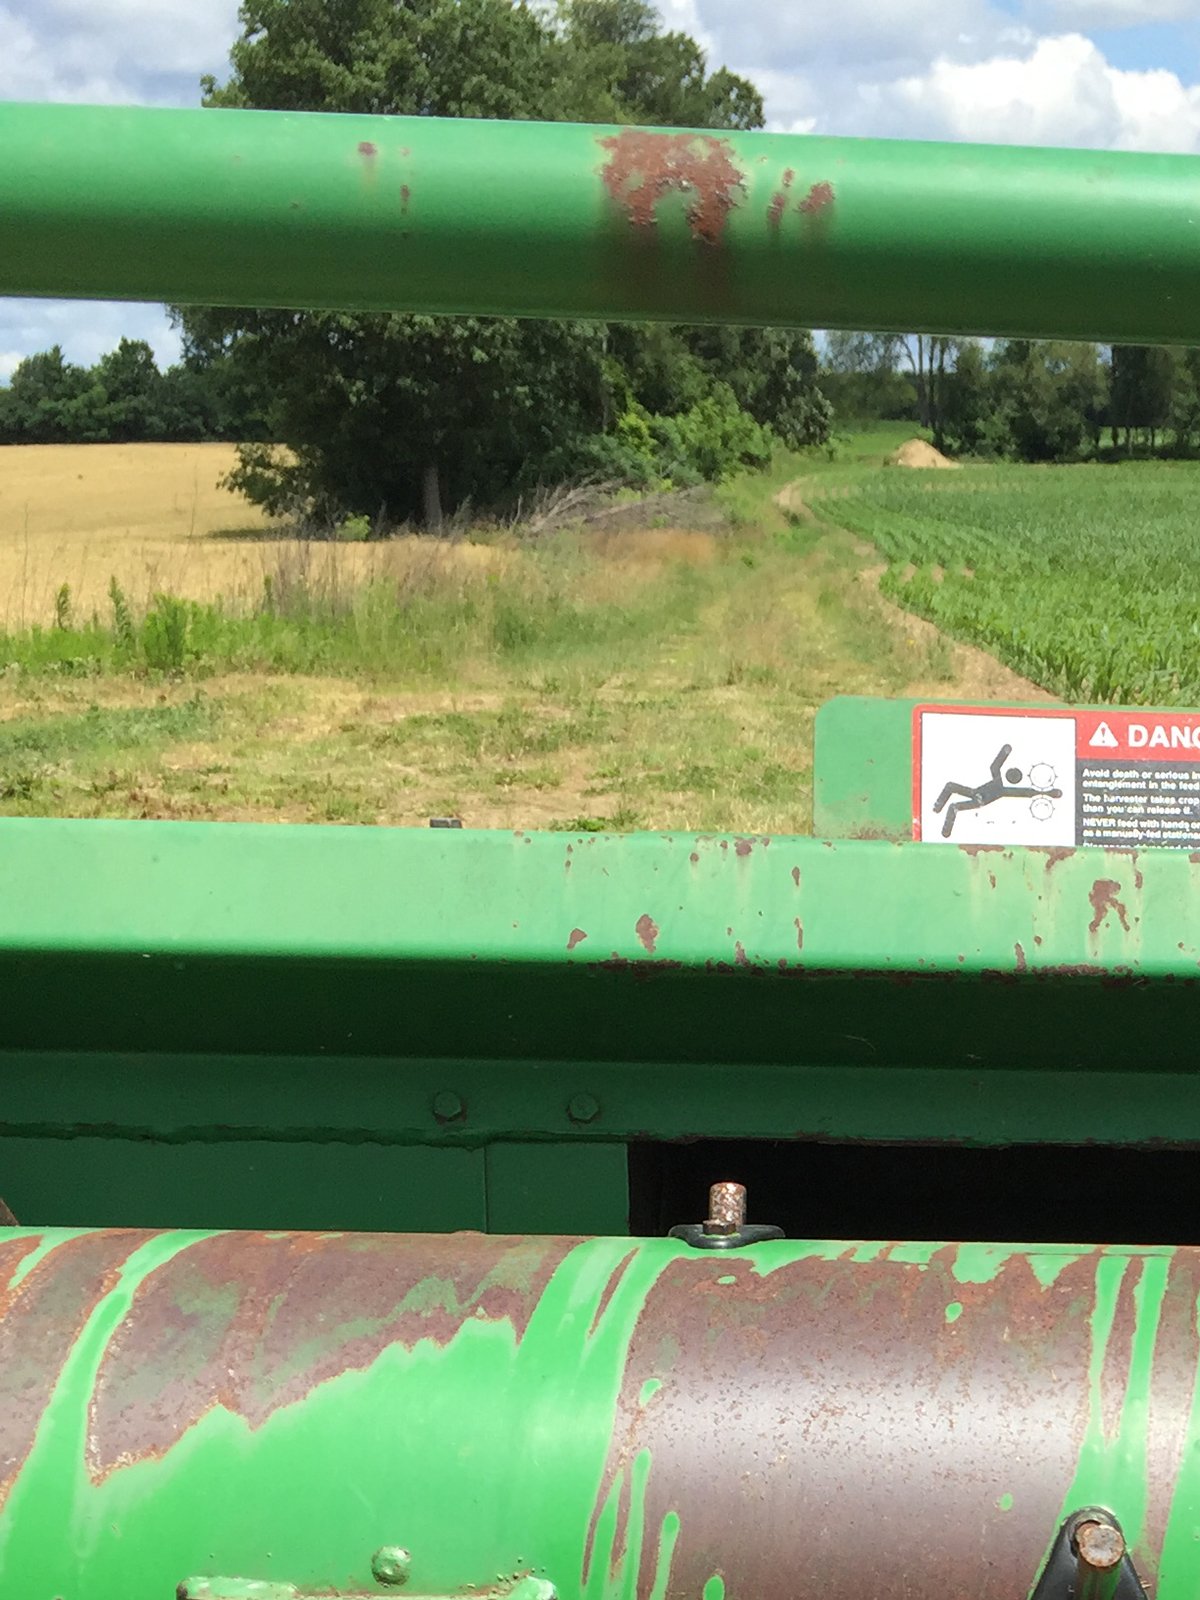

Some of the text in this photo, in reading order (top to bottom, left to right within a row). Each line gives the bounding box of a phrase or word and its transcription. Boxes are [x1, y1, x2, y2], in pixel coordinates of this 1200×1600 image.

[1082, 768, 1110, 778] Avoid
[1112, 769, 1139, 779] death
[1141, 771, 1153, 779] or
[1154, 770, 1190, 780] serious
[1082, 779, 1147, 790] entanglement
[1148, 780, 1159, 789] in
[1161, 781, 1176, 790] the
[1179, 781, 1200, 790] feed
[1082, 793, 1101, 802] The
[1103, 793, 1148, 803] harvester
[1150, 794, 1176, 804] takes
[1178, 797, 1200, 806] crop
[1082, 803, 1104, 813] than
[1106, 805, 1125, 815] you
[1126, 806, 1145, 814] can
[1146, 806, 1182, 814] release
[1082, 817, 1116, 827] NEVER
[1117, 818, 1139, 828] feed
[1139, 819, 1160, 828] with
[1161, 819, 1190, 829] hands
[1190, 821, 1200, 829] or
[1082, 829, 1094, 837] as
[1095, 829, 1102, 837] a
[1103, 829, 1161, 840] manually-fed
